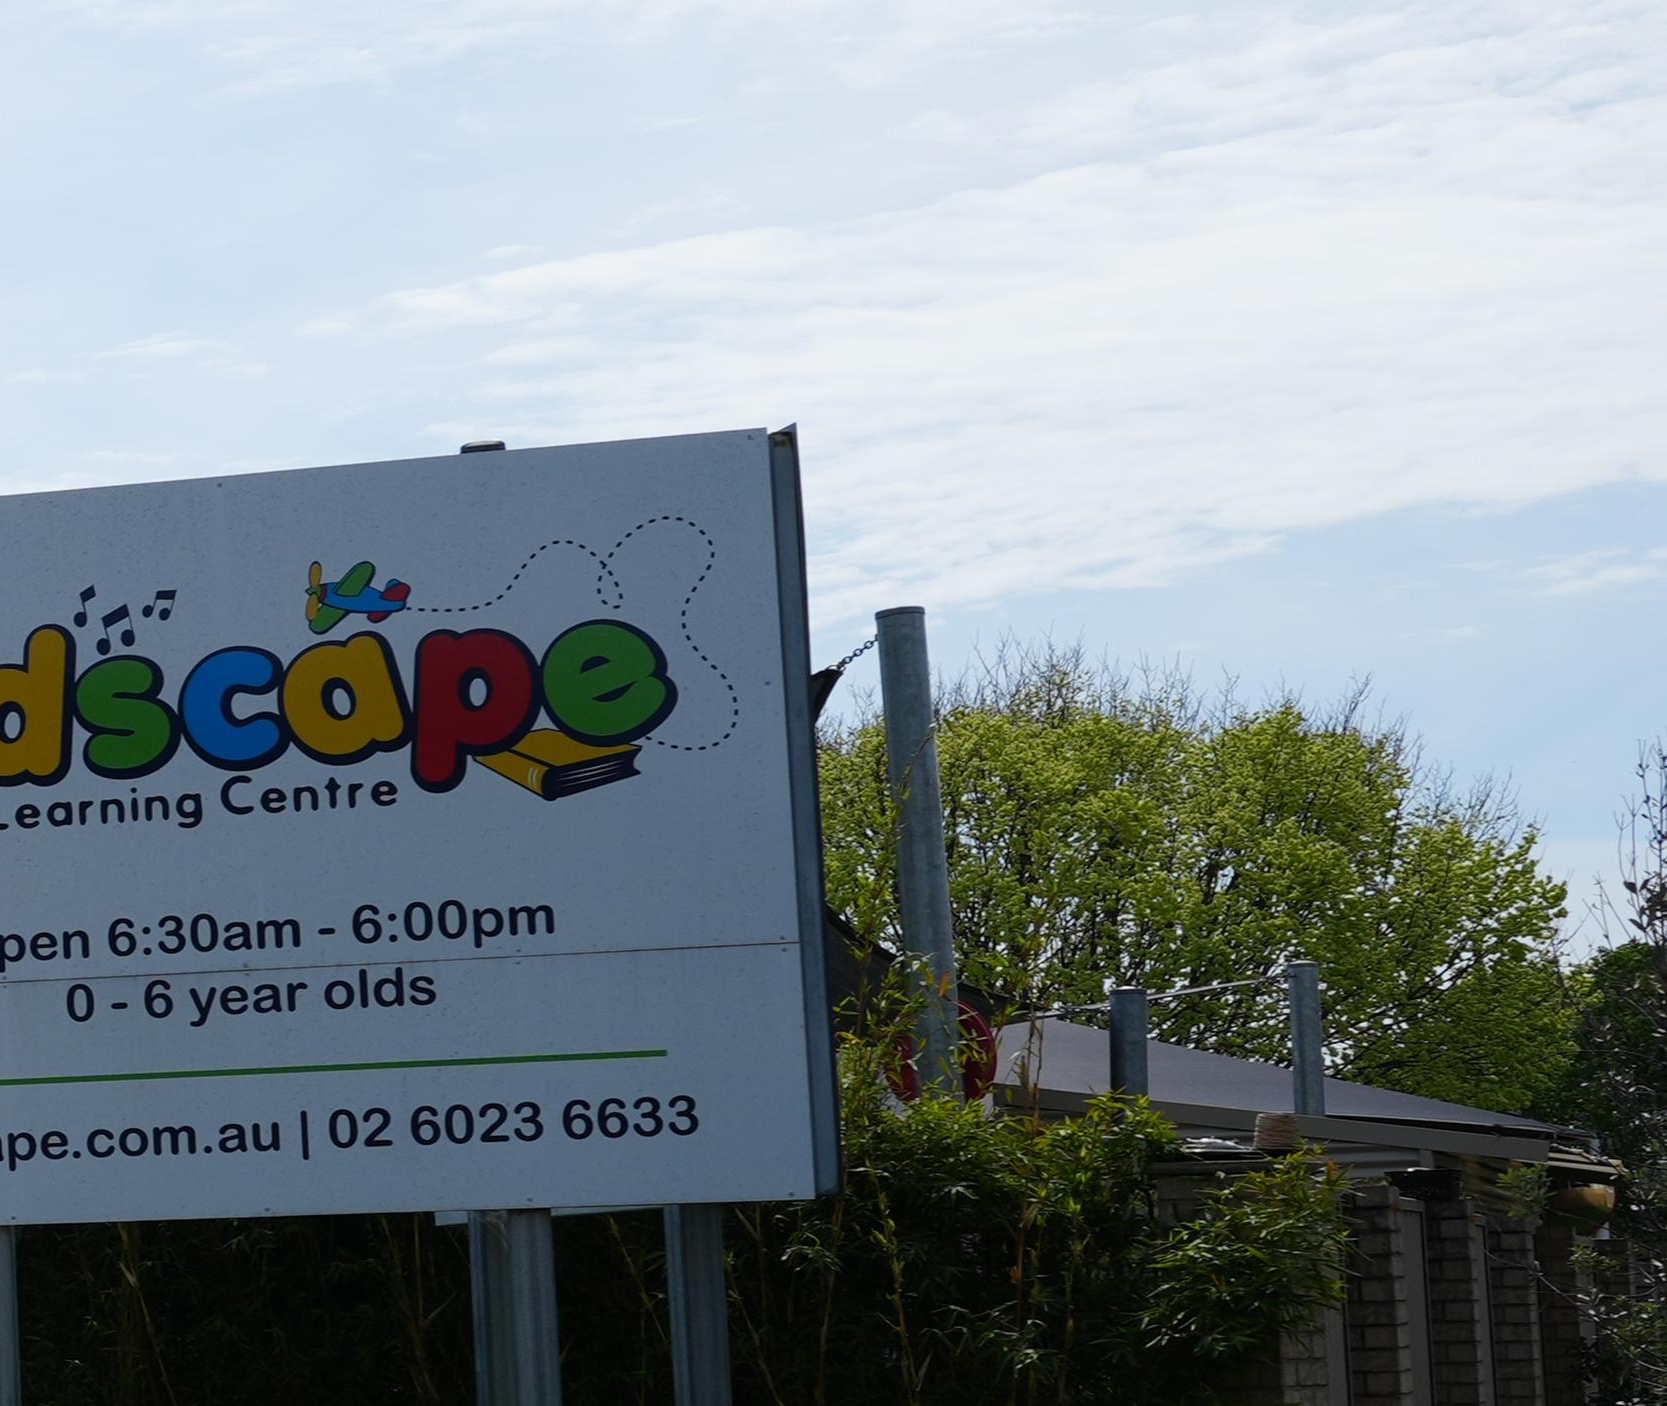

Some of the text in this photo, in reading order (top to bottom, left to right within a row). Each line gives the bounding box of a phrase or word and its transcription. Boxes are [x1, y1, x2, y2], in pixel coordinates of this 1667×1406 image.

[221, 775, 398, 815] Centre
[108, 912, 301, 957] 6:30am
[352, 900, 555, 948] 6:00pm
[67, 984, 94, 1022] 0
[144, 979, 173, 1018] 6
[189, 982, 308, 1027] year
[324, 967, 436, 1009] olds
[329, 1108, 393, 1149] 02
[410, 1101, 544, 1145] 6023
[562, 1095, 699, 1140] 6633
